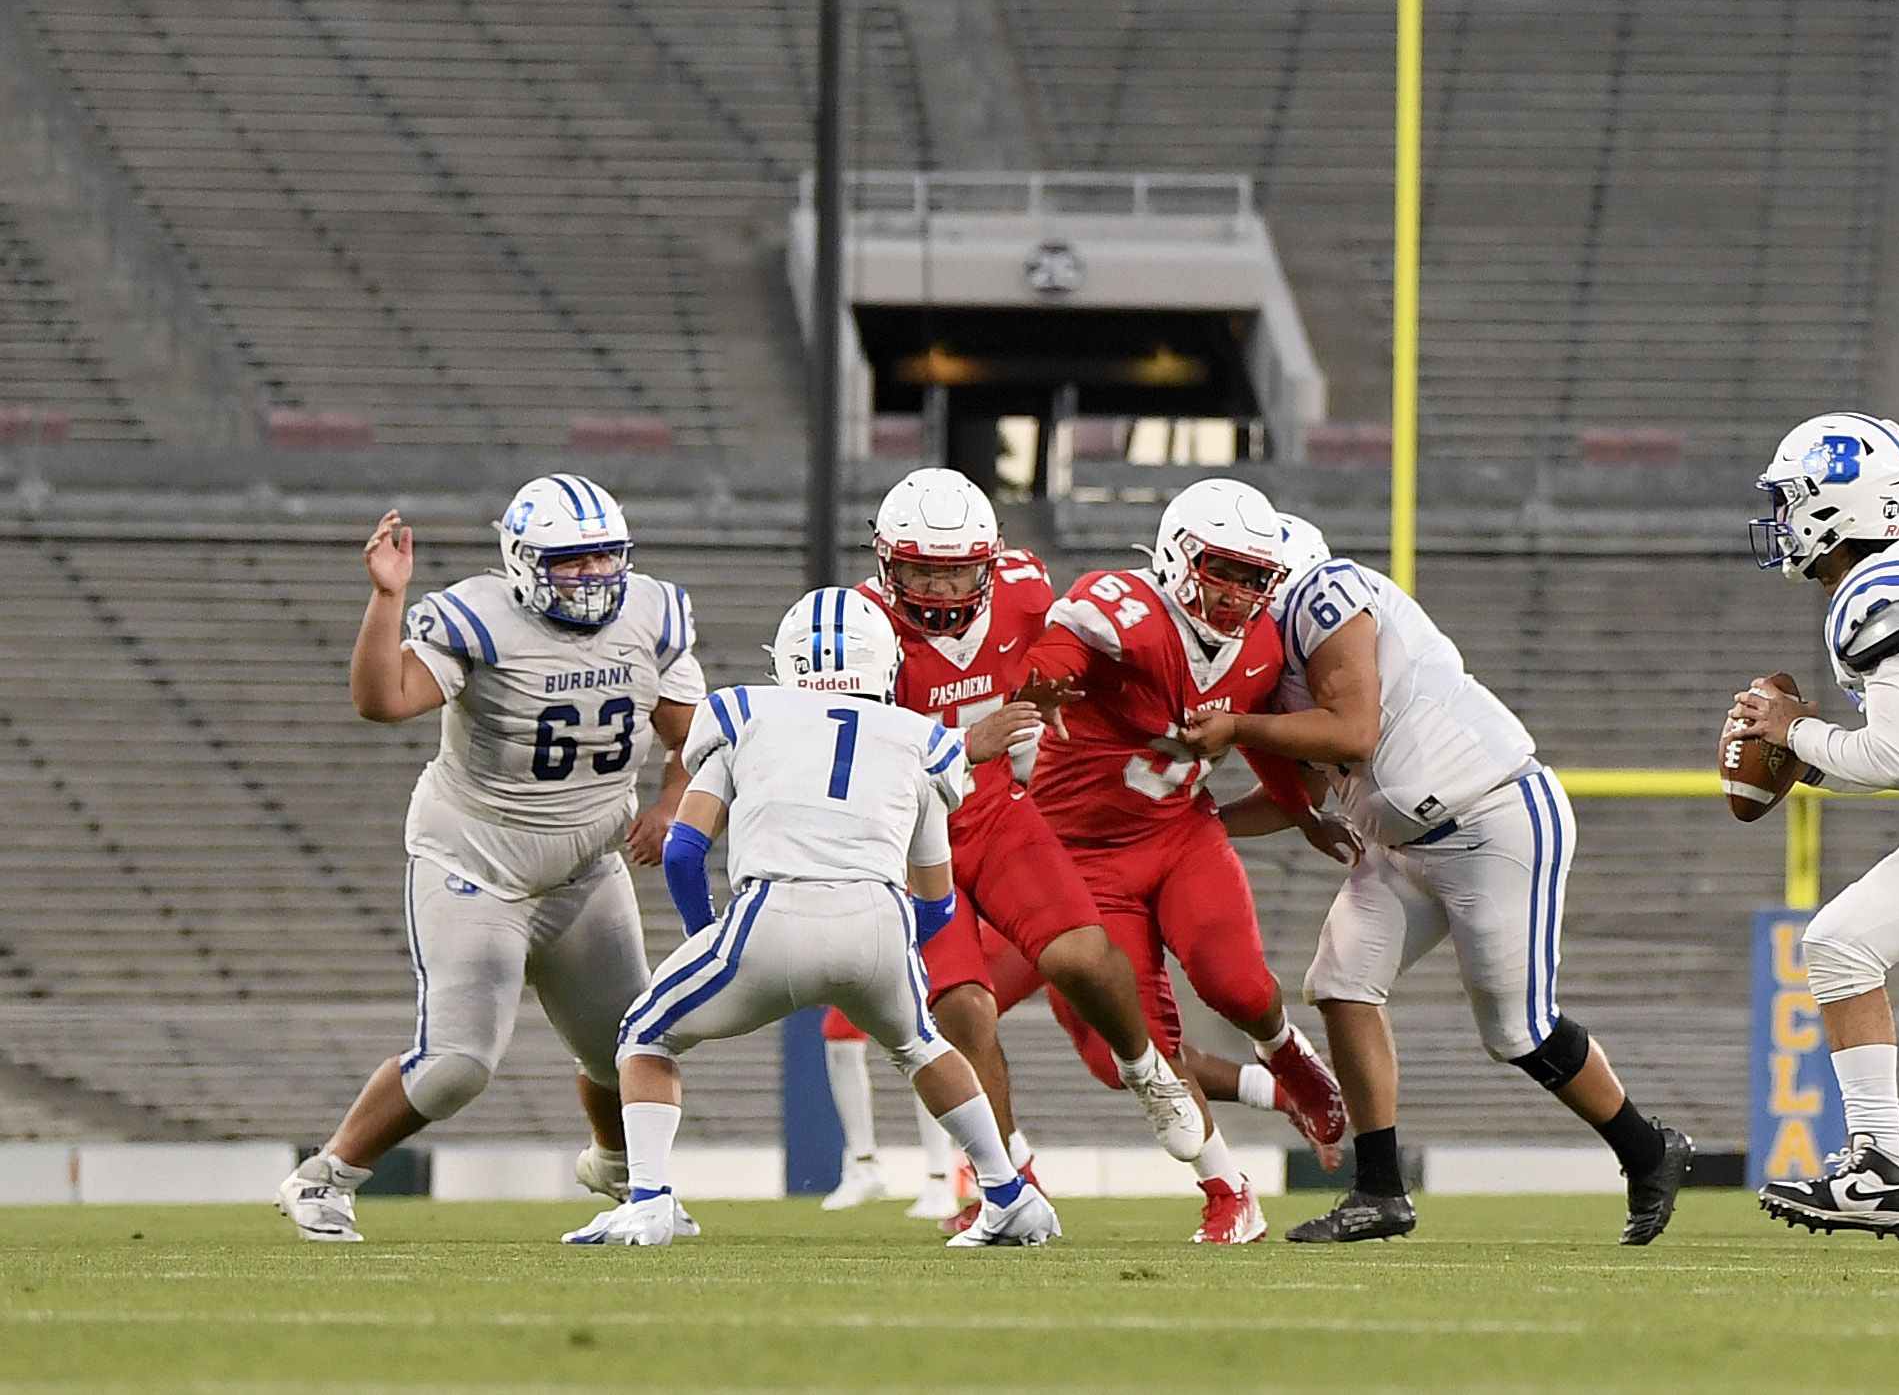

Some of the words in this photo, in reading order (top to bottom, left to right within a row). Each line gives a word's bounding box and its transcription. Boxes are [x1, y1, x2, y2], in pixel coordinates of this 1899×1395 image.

[1090, 574, 1151, 629] 54
[1308, 580, 1357, 630] 61
[545, 664, 634, 694] BURBANK
[927, 674, 993, 708] PASADENA
[531, 696, 636, 781] 63
[826, 708, 860, 801] 1
